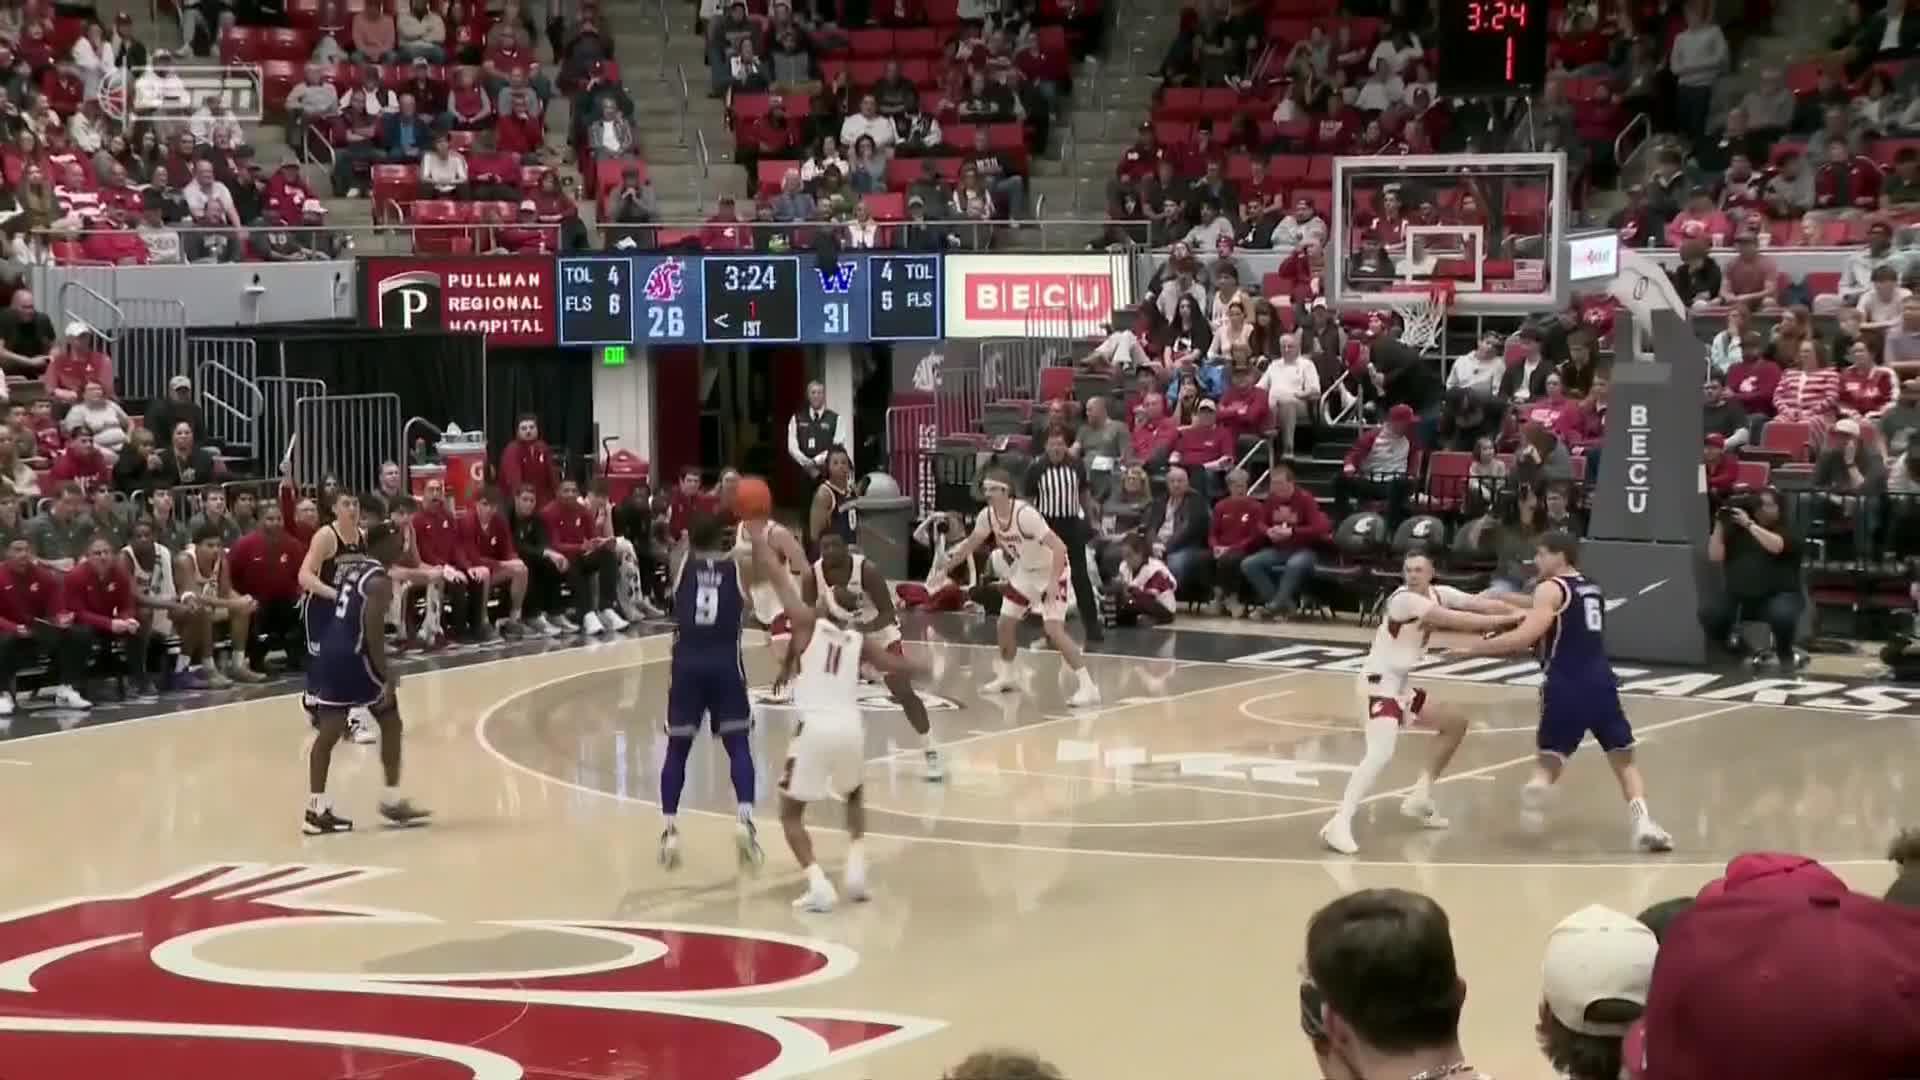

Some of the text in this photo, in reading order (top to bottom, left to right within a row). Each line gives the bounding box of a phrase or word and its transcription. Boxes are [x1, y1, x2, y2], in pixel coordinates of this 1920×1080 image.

[1467, 2, 1526, 31] 3:24
[1506, 36, 1513, 80] 1
[448, 272, 540, 288] PULLMAN
[564, 265, 619, 286] TOL 4
[725, 265, 776, 290] 3:24
[881, 261, 934, 281] 4 TOL
[448, 295, 543, 311] REGIONAL
[565, 296, 592, 312] FLS
[881, 290, 933, 311] 5 FLS
[648, 306, 685, 337] 26
[823, 303, 849, 333] 31
[335, 582, 352, 618] 5
[1584, 597, 1602, 631] 6
[824, 642, 842, 675] 11
